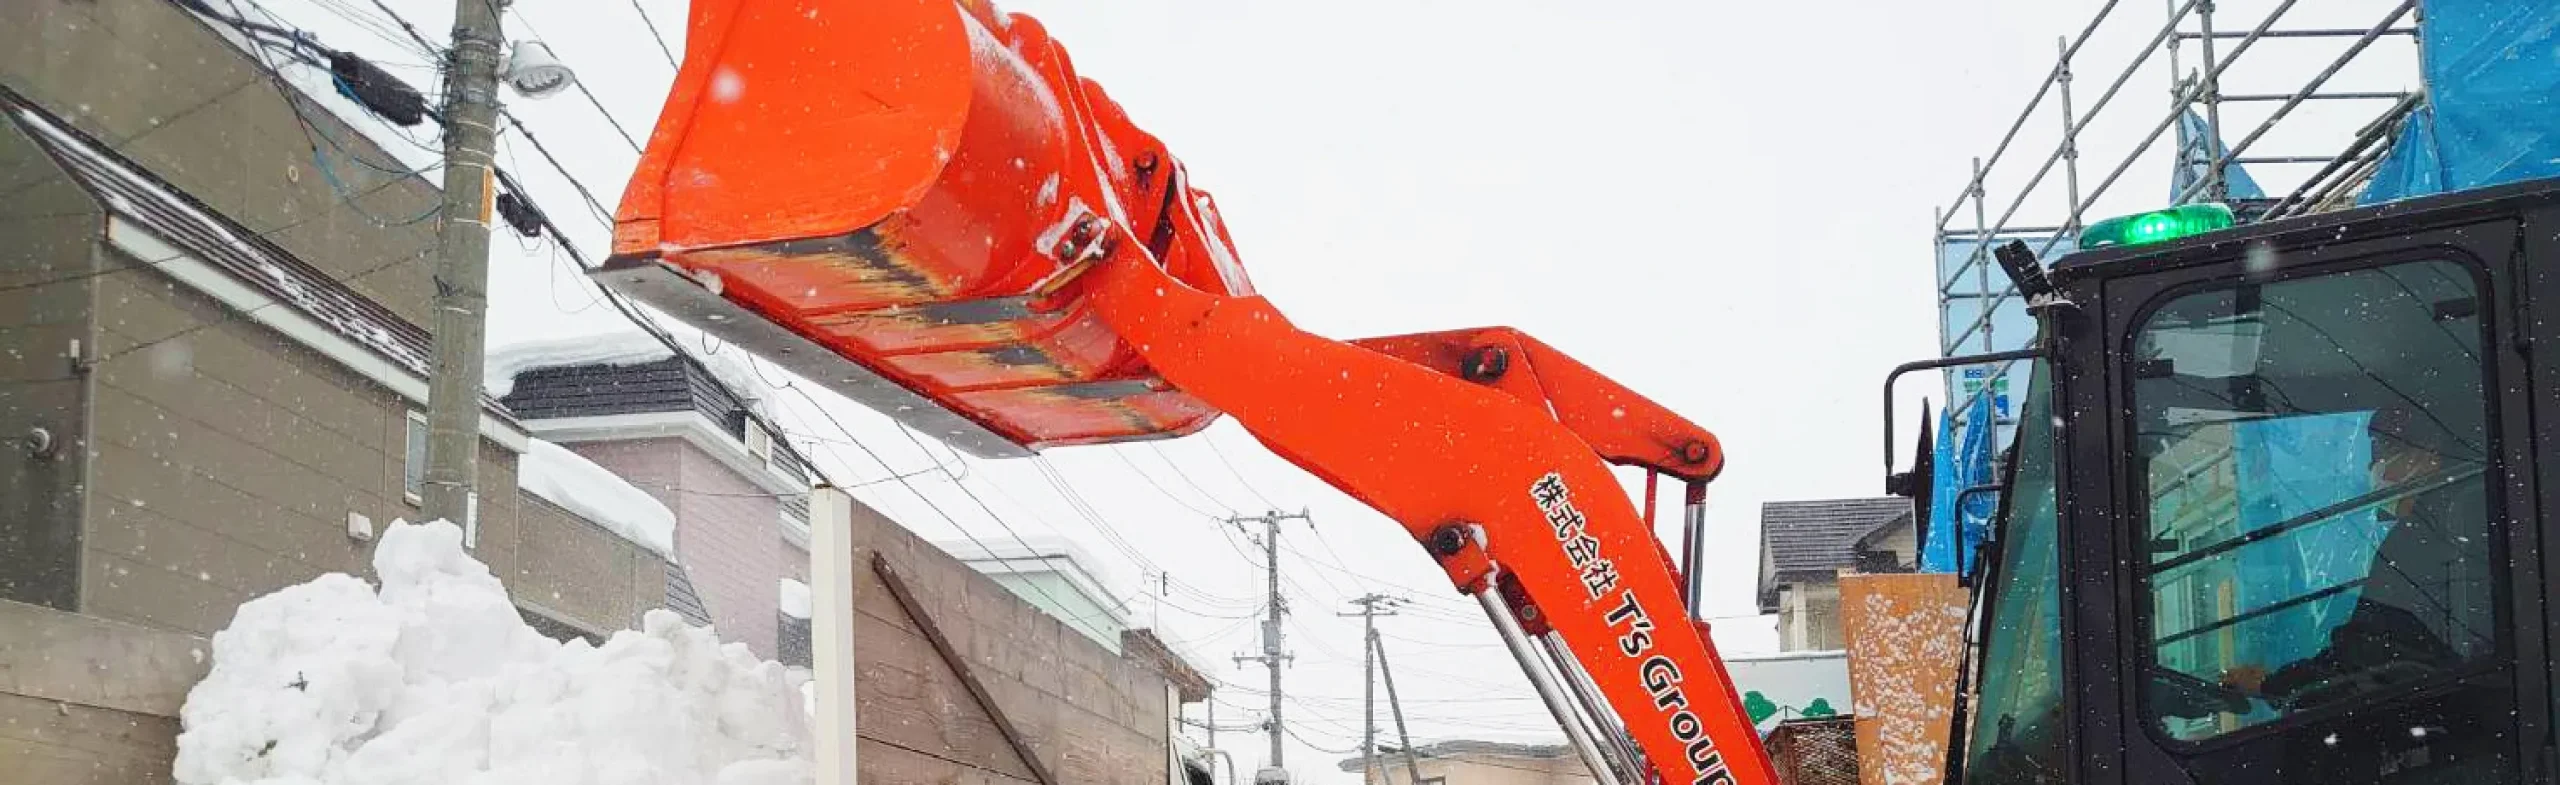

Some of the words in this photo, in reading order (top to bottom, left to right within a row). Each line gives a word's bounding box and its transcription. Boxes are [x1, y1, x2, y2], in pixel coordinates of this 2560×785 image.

[1532, 474, 1615, 597] 株式会社
[1606, 591, 1653, 655] T's
